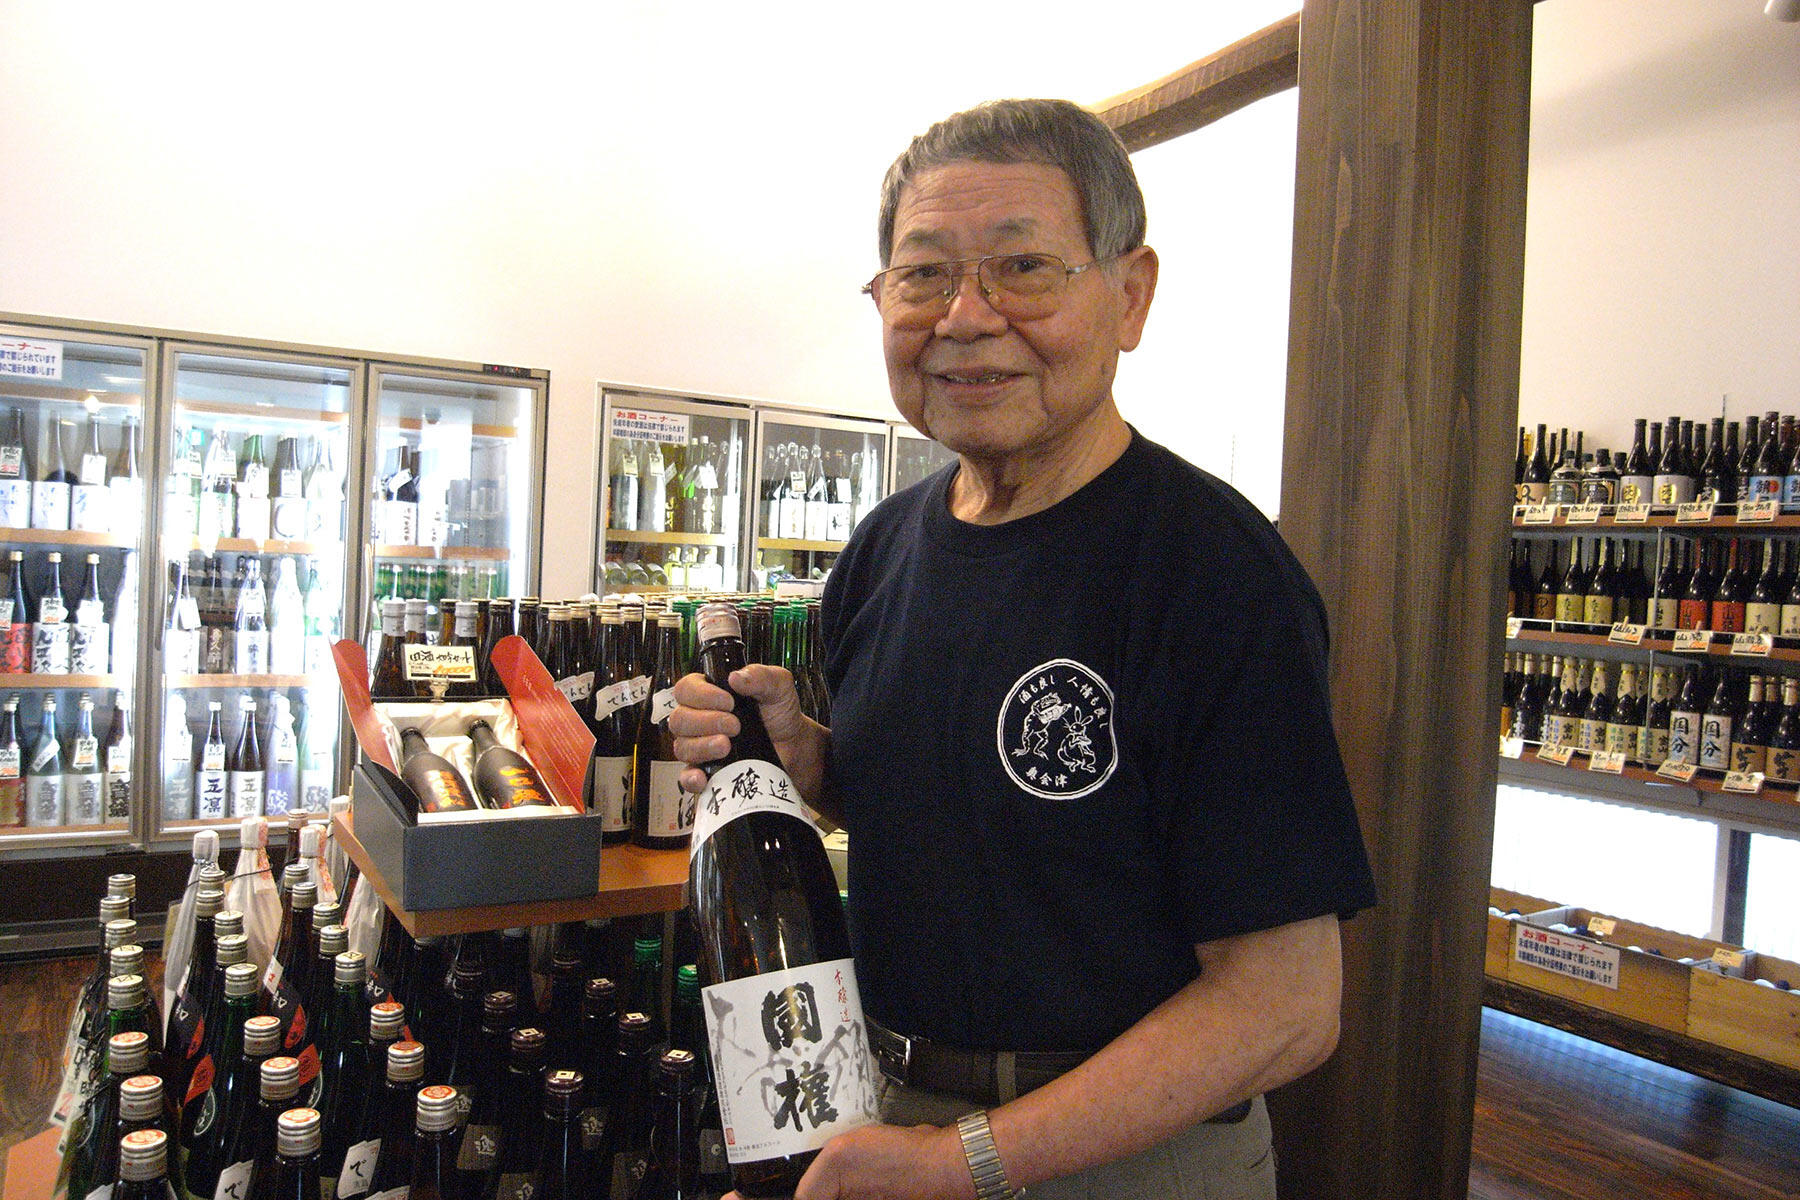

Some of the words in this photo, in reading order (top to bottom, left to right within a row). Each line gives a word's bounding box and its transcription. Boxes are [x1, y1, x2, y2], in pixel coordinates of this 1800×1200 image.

[616, 410, 679, 422] お酒コーナー
[707, 767, 796, 816] 本醸造
[1523, 929, 1605, 955] お酒コーナー
